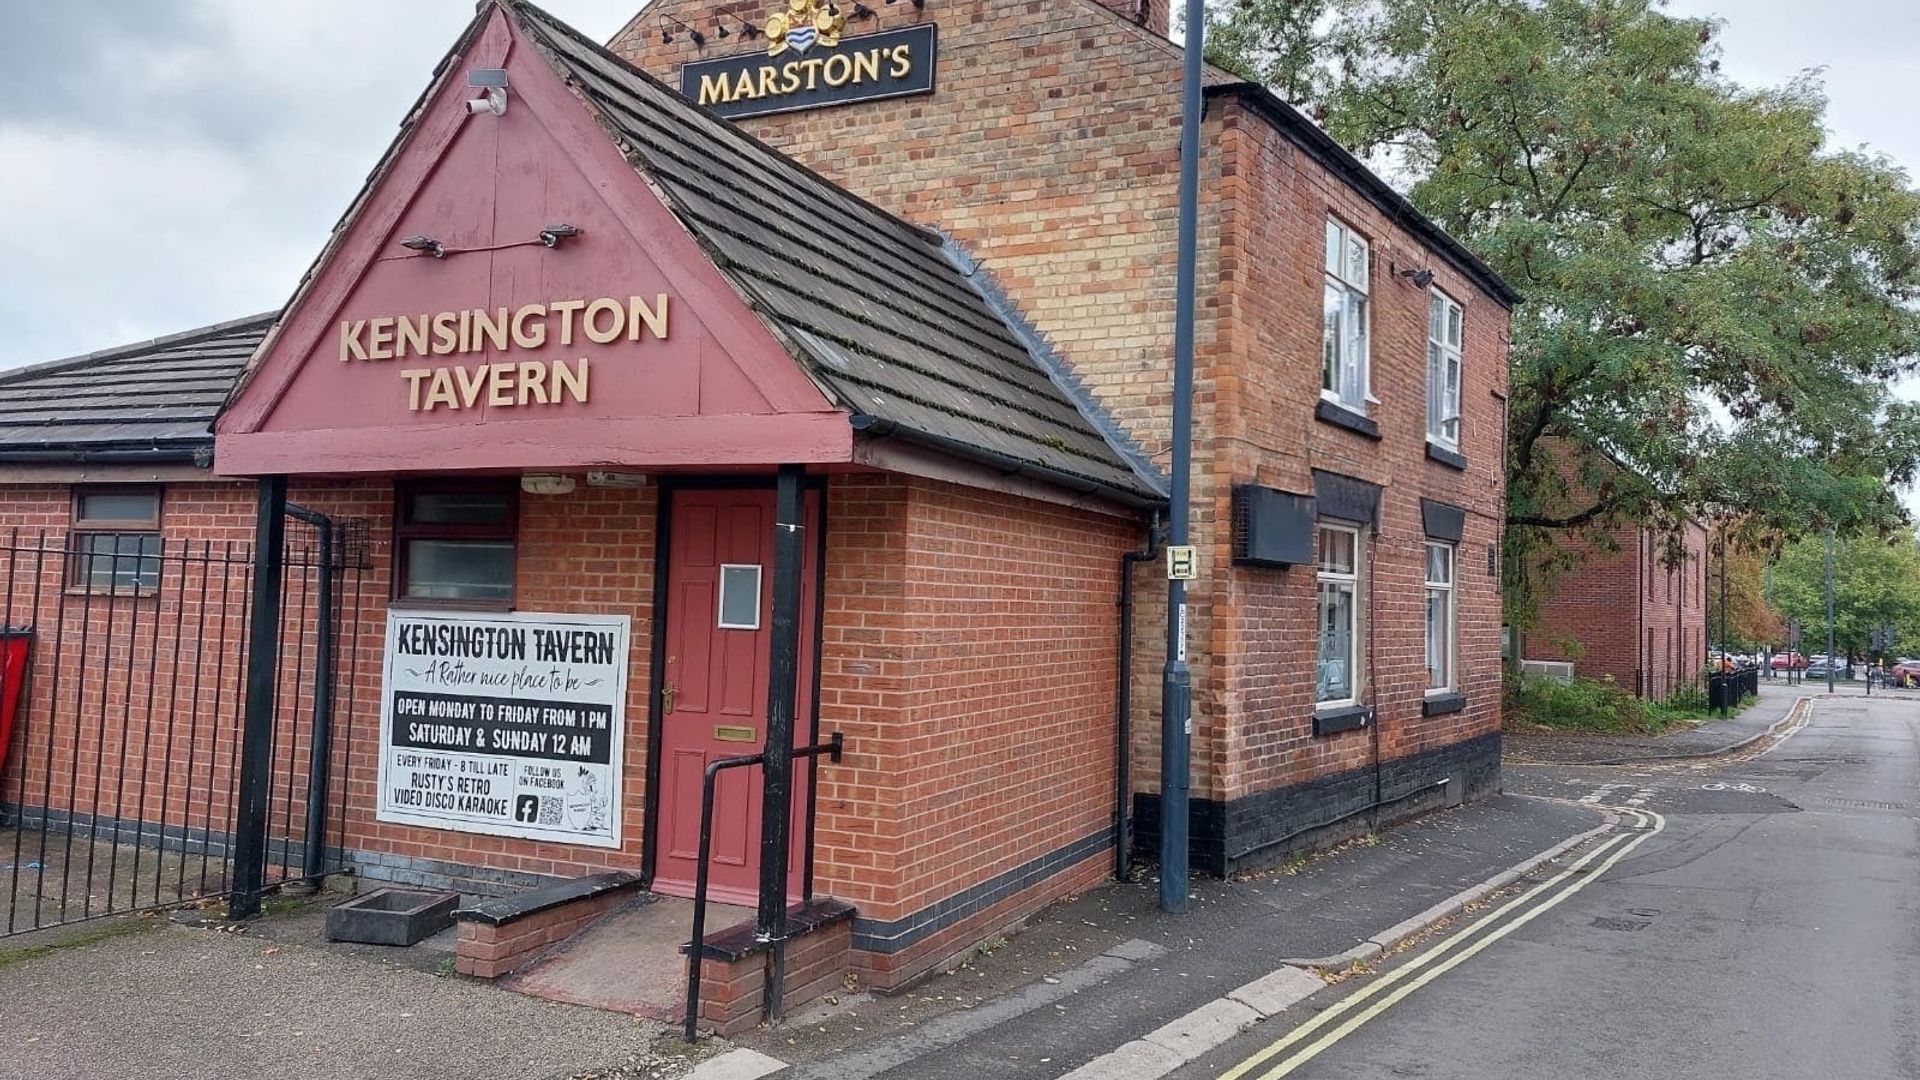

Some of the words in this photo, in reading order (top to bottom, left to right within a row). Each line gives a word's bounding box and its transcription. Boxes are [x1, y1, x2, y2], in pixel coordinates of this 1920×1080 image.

[698, 44, 912, 106] MARSTON'S
[339, 293, 668, 362] KENSINGTON
[400, 358, 589, 411] TAVERN
[398, 624, 526, 660] KENSINGTON
[533, 629, 614, 665] TAVERN
[425, 660, 436, 683] A
[439, 660, 475, 686] Rather
[480, 669, 508, 685] nice
[511, 665, 547, 695] place
[548, 665, 562, 690] to
[565, 671, 582, 693] be
[398, 699, 425, 715] OPEN
[429, 701, 475, 720] MONDAY
[480, 704, 494, 720] TO
[498, 705, 538, 724] FRIDAY
[543, 708, 575, 726] FROM
[581, 711, 586, 727] 1
[589, 711, 606, 729] PM
[409, 724, 472, 747] SATURDAY
[476, 729, 486, 748] &
[493, 730, 547, 752] SUNDAY
[552, 734, 566, 753] 12
[570, 736, 591, 756] AM
[397, 755, 421, 769] EVERY
[424, 757, 452, 772] FRIDAY
[460, 760, 466, 772] 8
[469, 761, 483, 774] TILL
[487, 762, 508, 777] LATE
[524, 766, 550, 776] FOLLOW
[552, 768, 561, 778] US
[411, 772, 454, 791] RUSTY'S
[457, 777, 490, 795] RETRO
[530, 777, 564, 789] FACEBOOK
[394, 788, 421, 806] VIDEO
[425, 792, 454, 809] DISCO
[458, 795, 508, 816] KARAOKE
